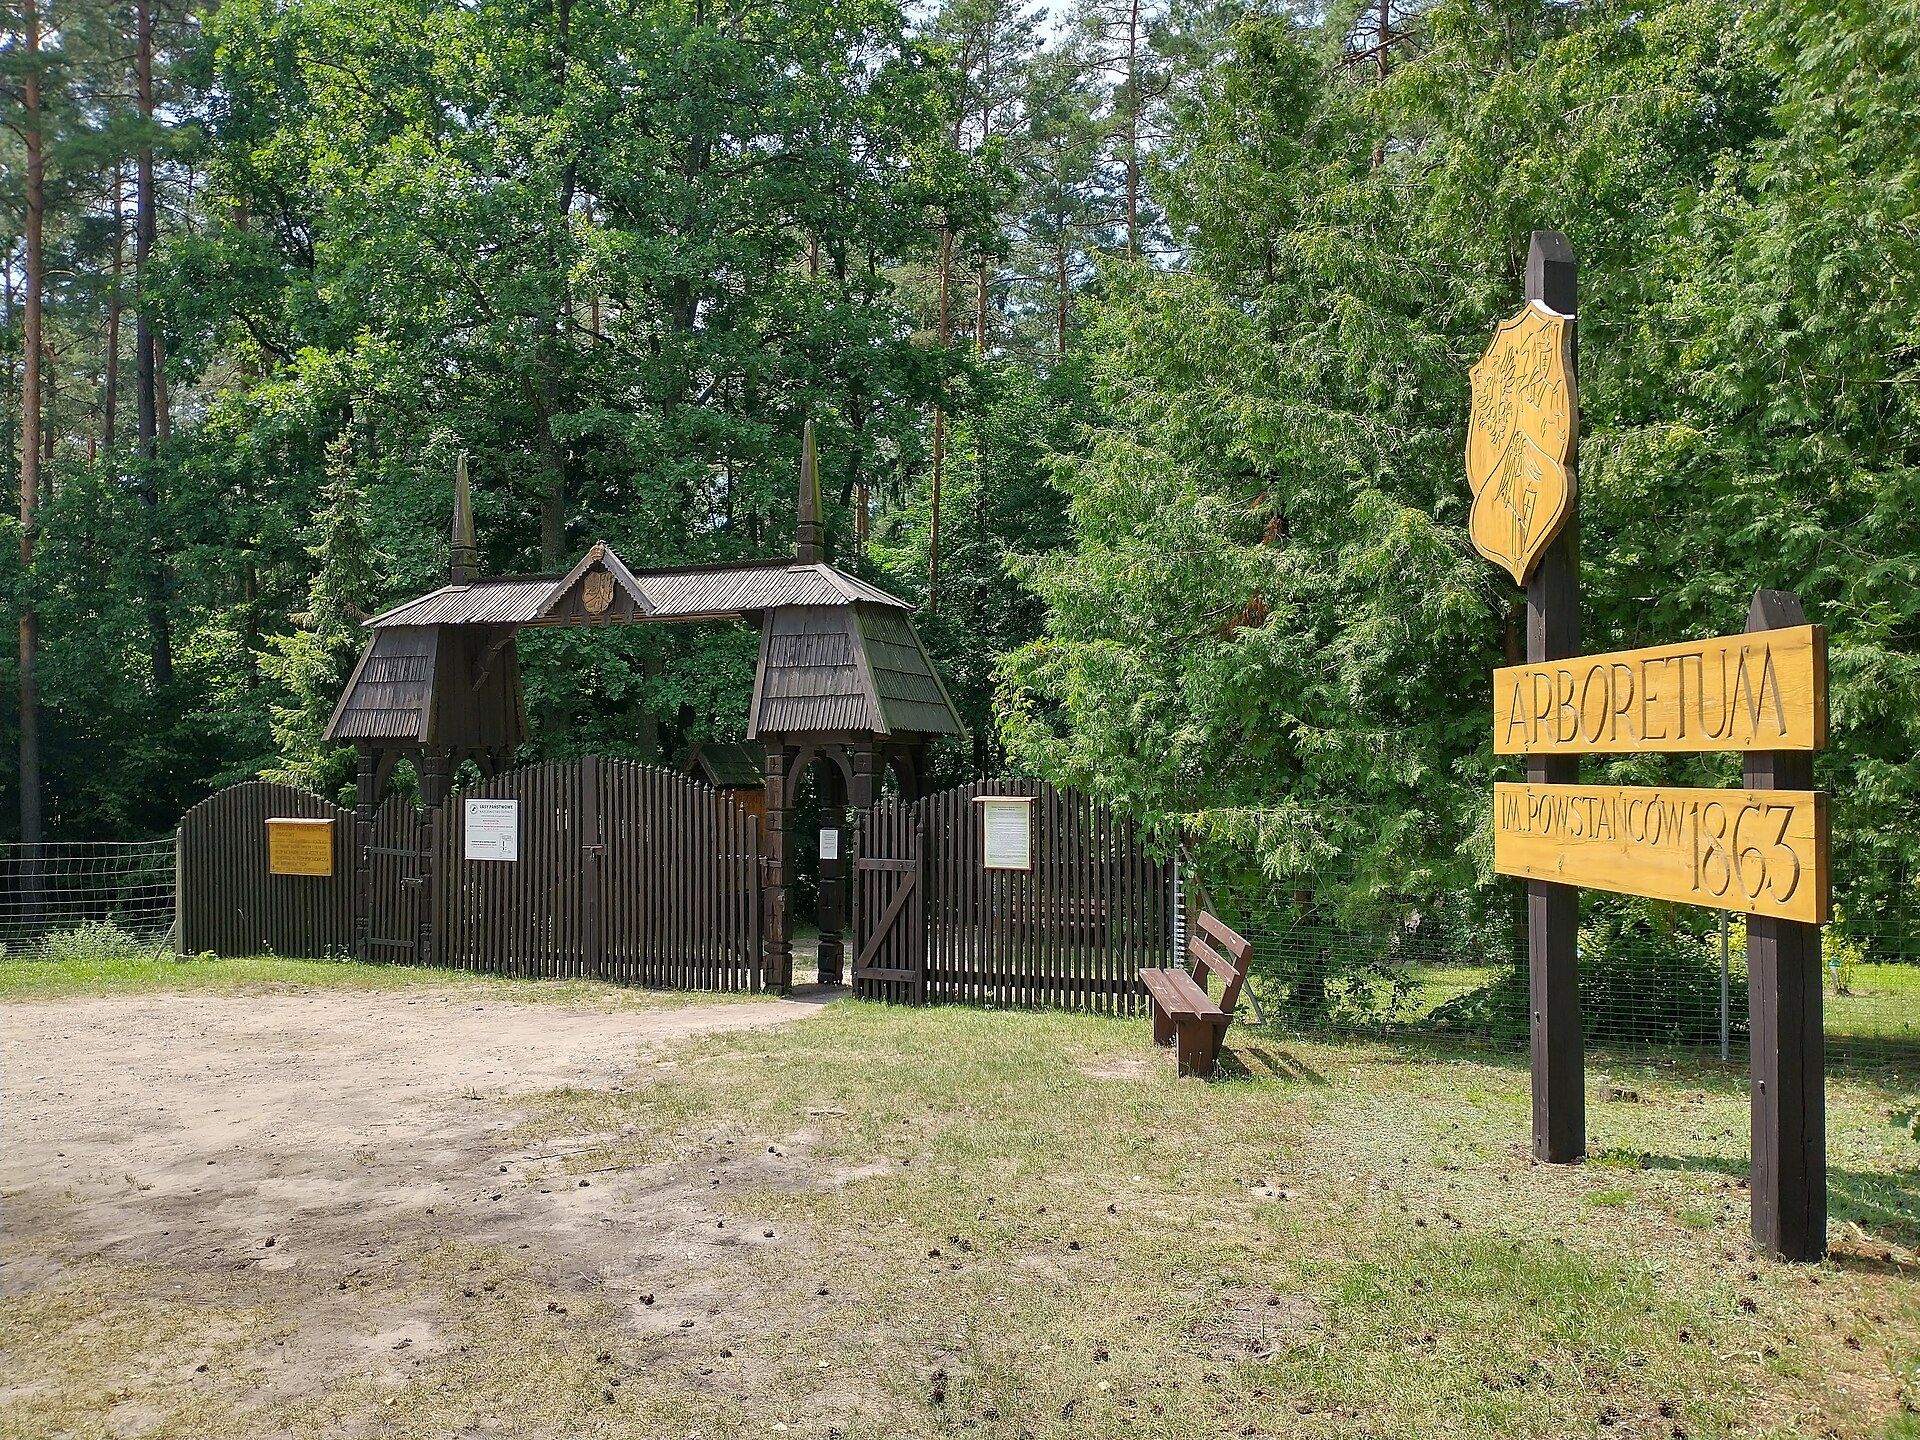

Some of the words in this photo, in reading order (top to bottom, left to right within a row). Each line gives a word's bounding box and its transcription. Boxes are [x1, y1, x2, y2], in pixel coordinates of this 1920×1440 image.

[1505, 642, 1788, 749] ARBORETUM
[1527, 792, 1687, 847] POWSTAŃCÓW
[1689, 801, 1801, 906] 1863
